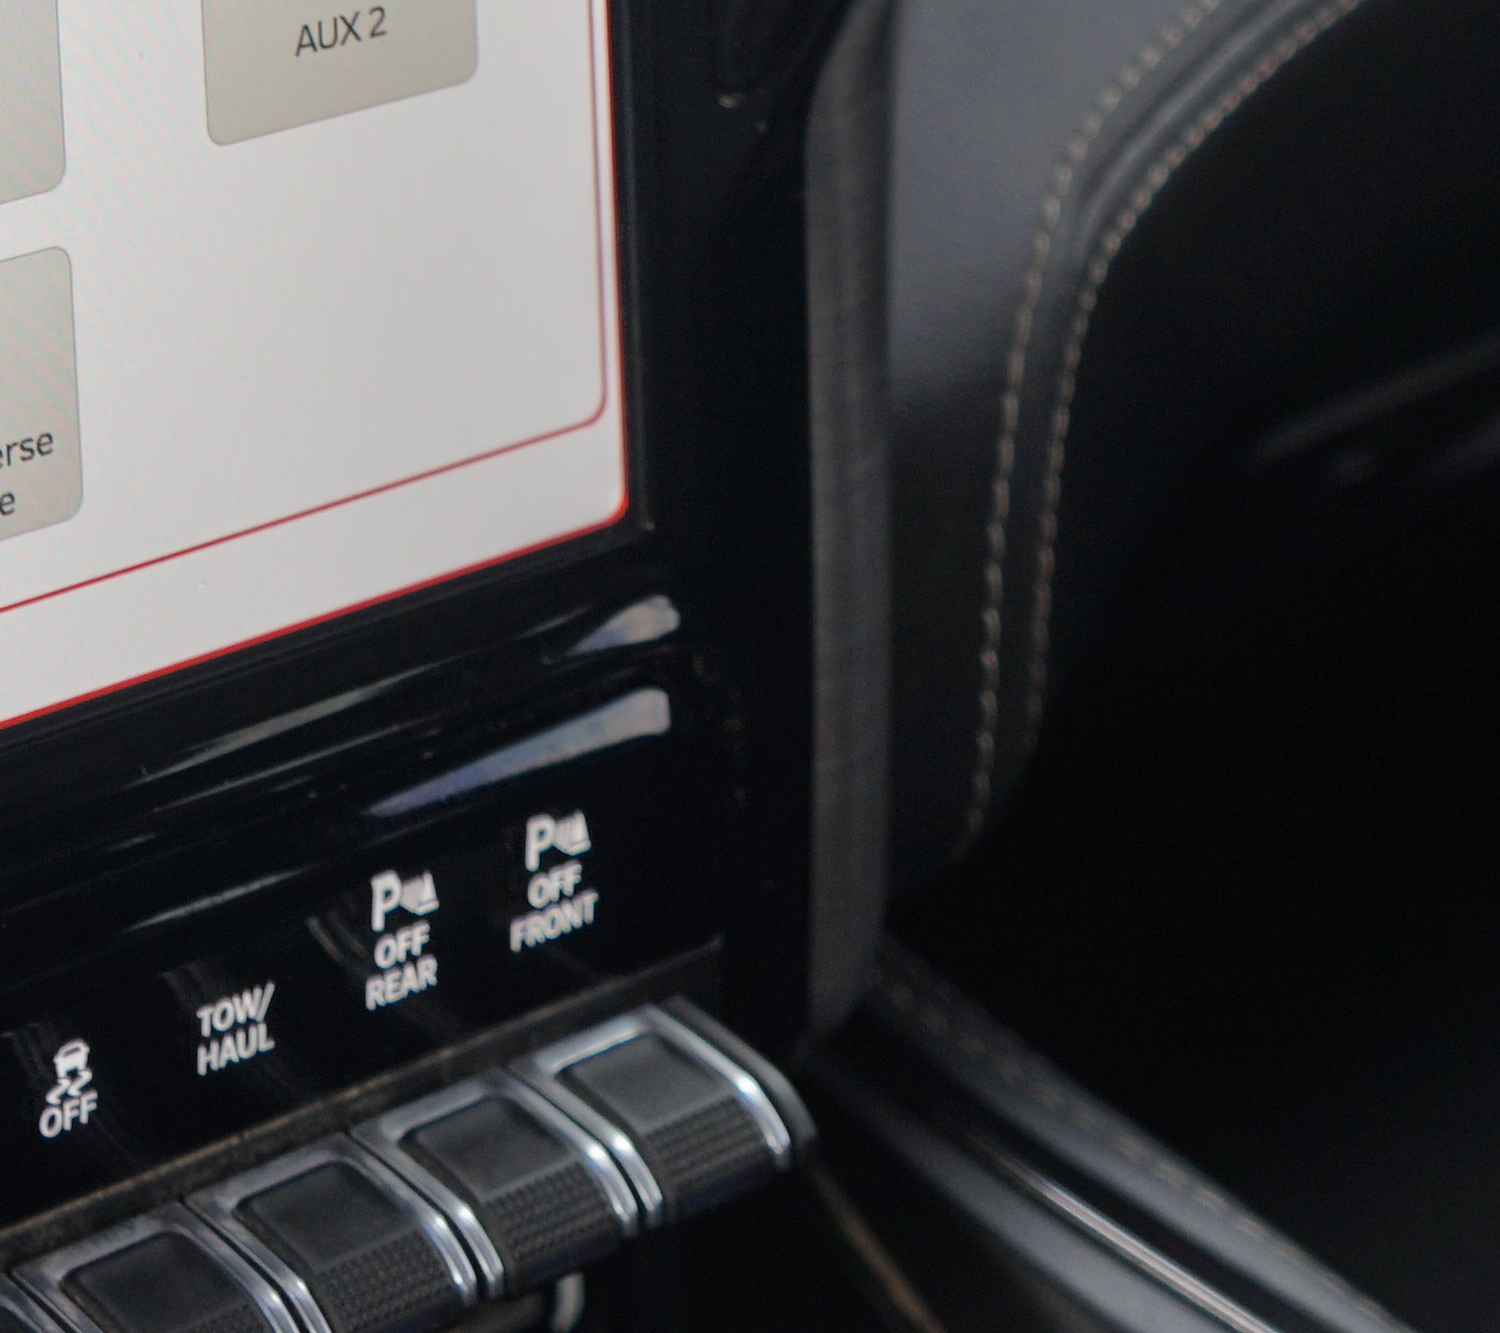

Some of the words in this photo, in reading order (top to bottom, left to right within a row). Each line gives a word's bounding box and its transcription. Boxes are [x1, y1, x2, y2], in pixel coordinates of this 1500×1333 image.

[295, 14, 361, 57] AUX
[367, 6, 387, 38] 2
[527, 860, 583, 909] OFF
[374, 920, 431, 969] OFF
[510, 888, 599, 953] FRONT
[365, 954, 438, 1011] REAR
[196, 981, 275, 1038] TOW/
[196, 1023, 275, 1076] HAUL
[38, 1091, 98, 1139] OFF
